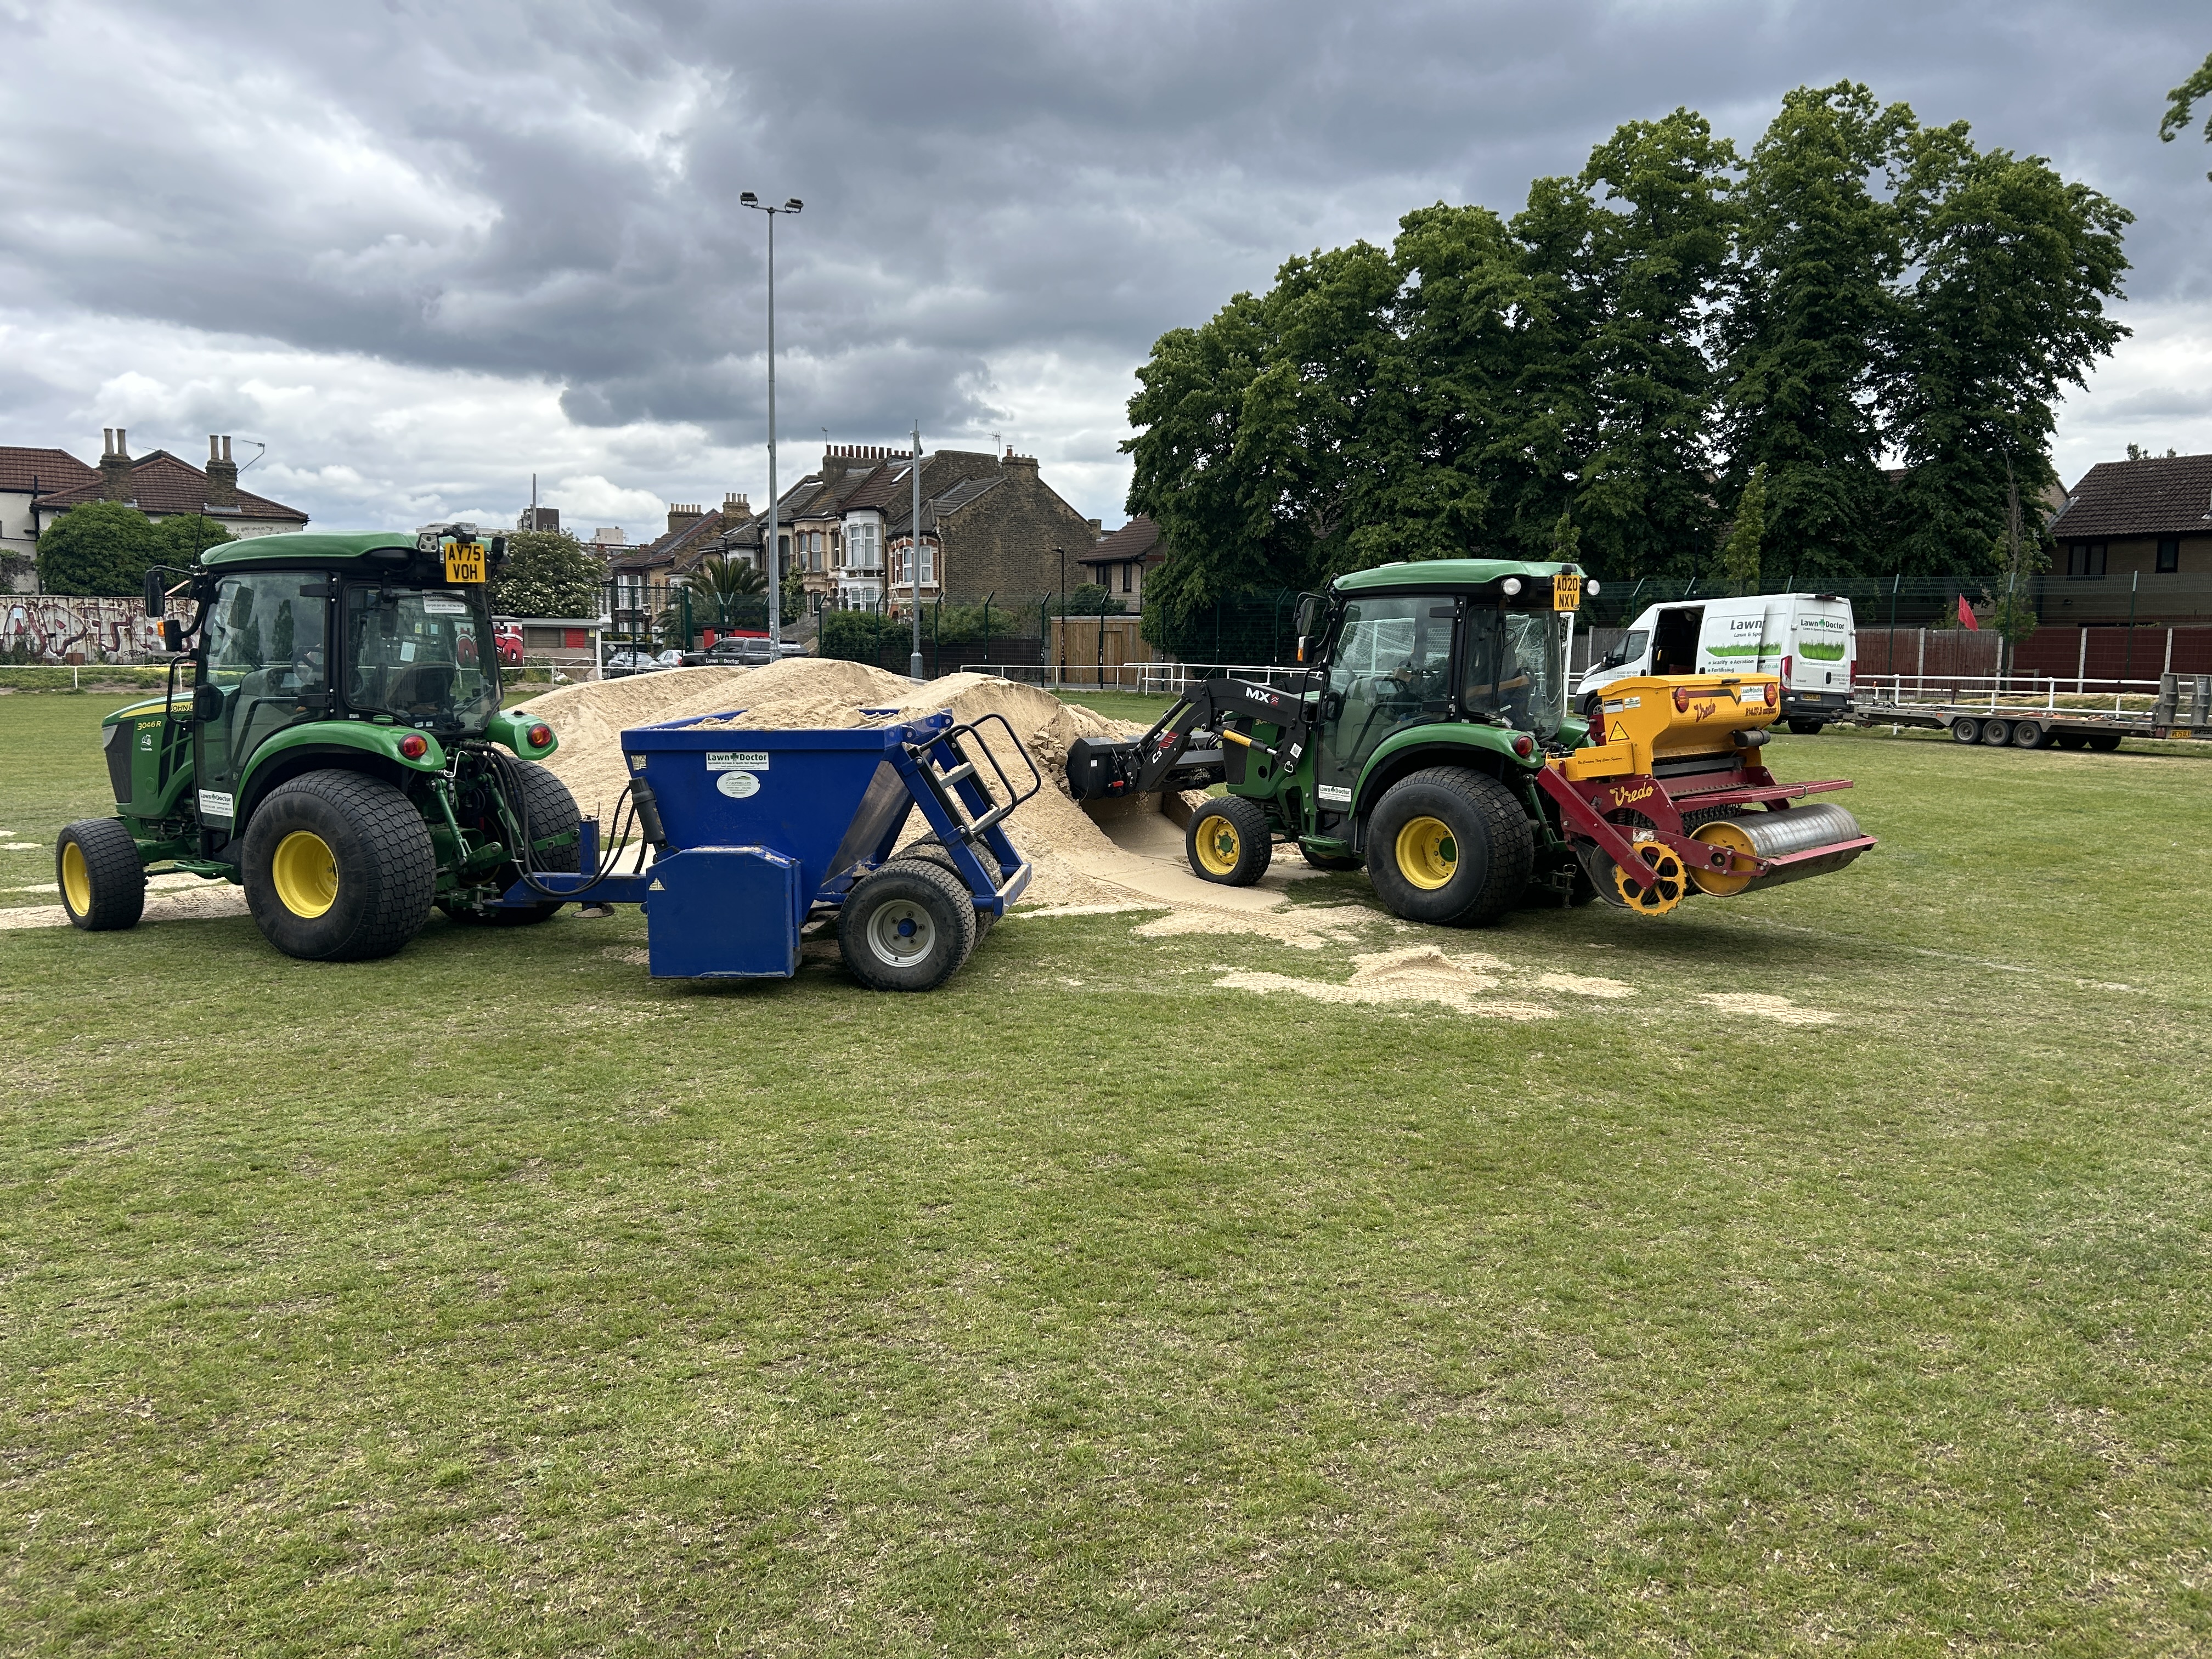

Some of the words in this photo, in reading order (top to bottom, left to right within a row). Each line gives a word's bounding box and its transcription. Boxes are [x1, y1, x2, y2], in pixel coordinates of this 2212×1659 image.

[448, 544, 481, 561] AY75
[453, 563, 478, 580] VOH
[1559, 593, 1575, 608] NXV
[1730, 620, 1763, 630] Lawn
[1801, 619, 1819, 627] Lawn
[1825, 620, 1845, 630] Doctor
[1246, 687, 1271, 703] MX
[1694, 698, 1717, 723] Vredo
[1609, 781, 1654, 806] Vredo
